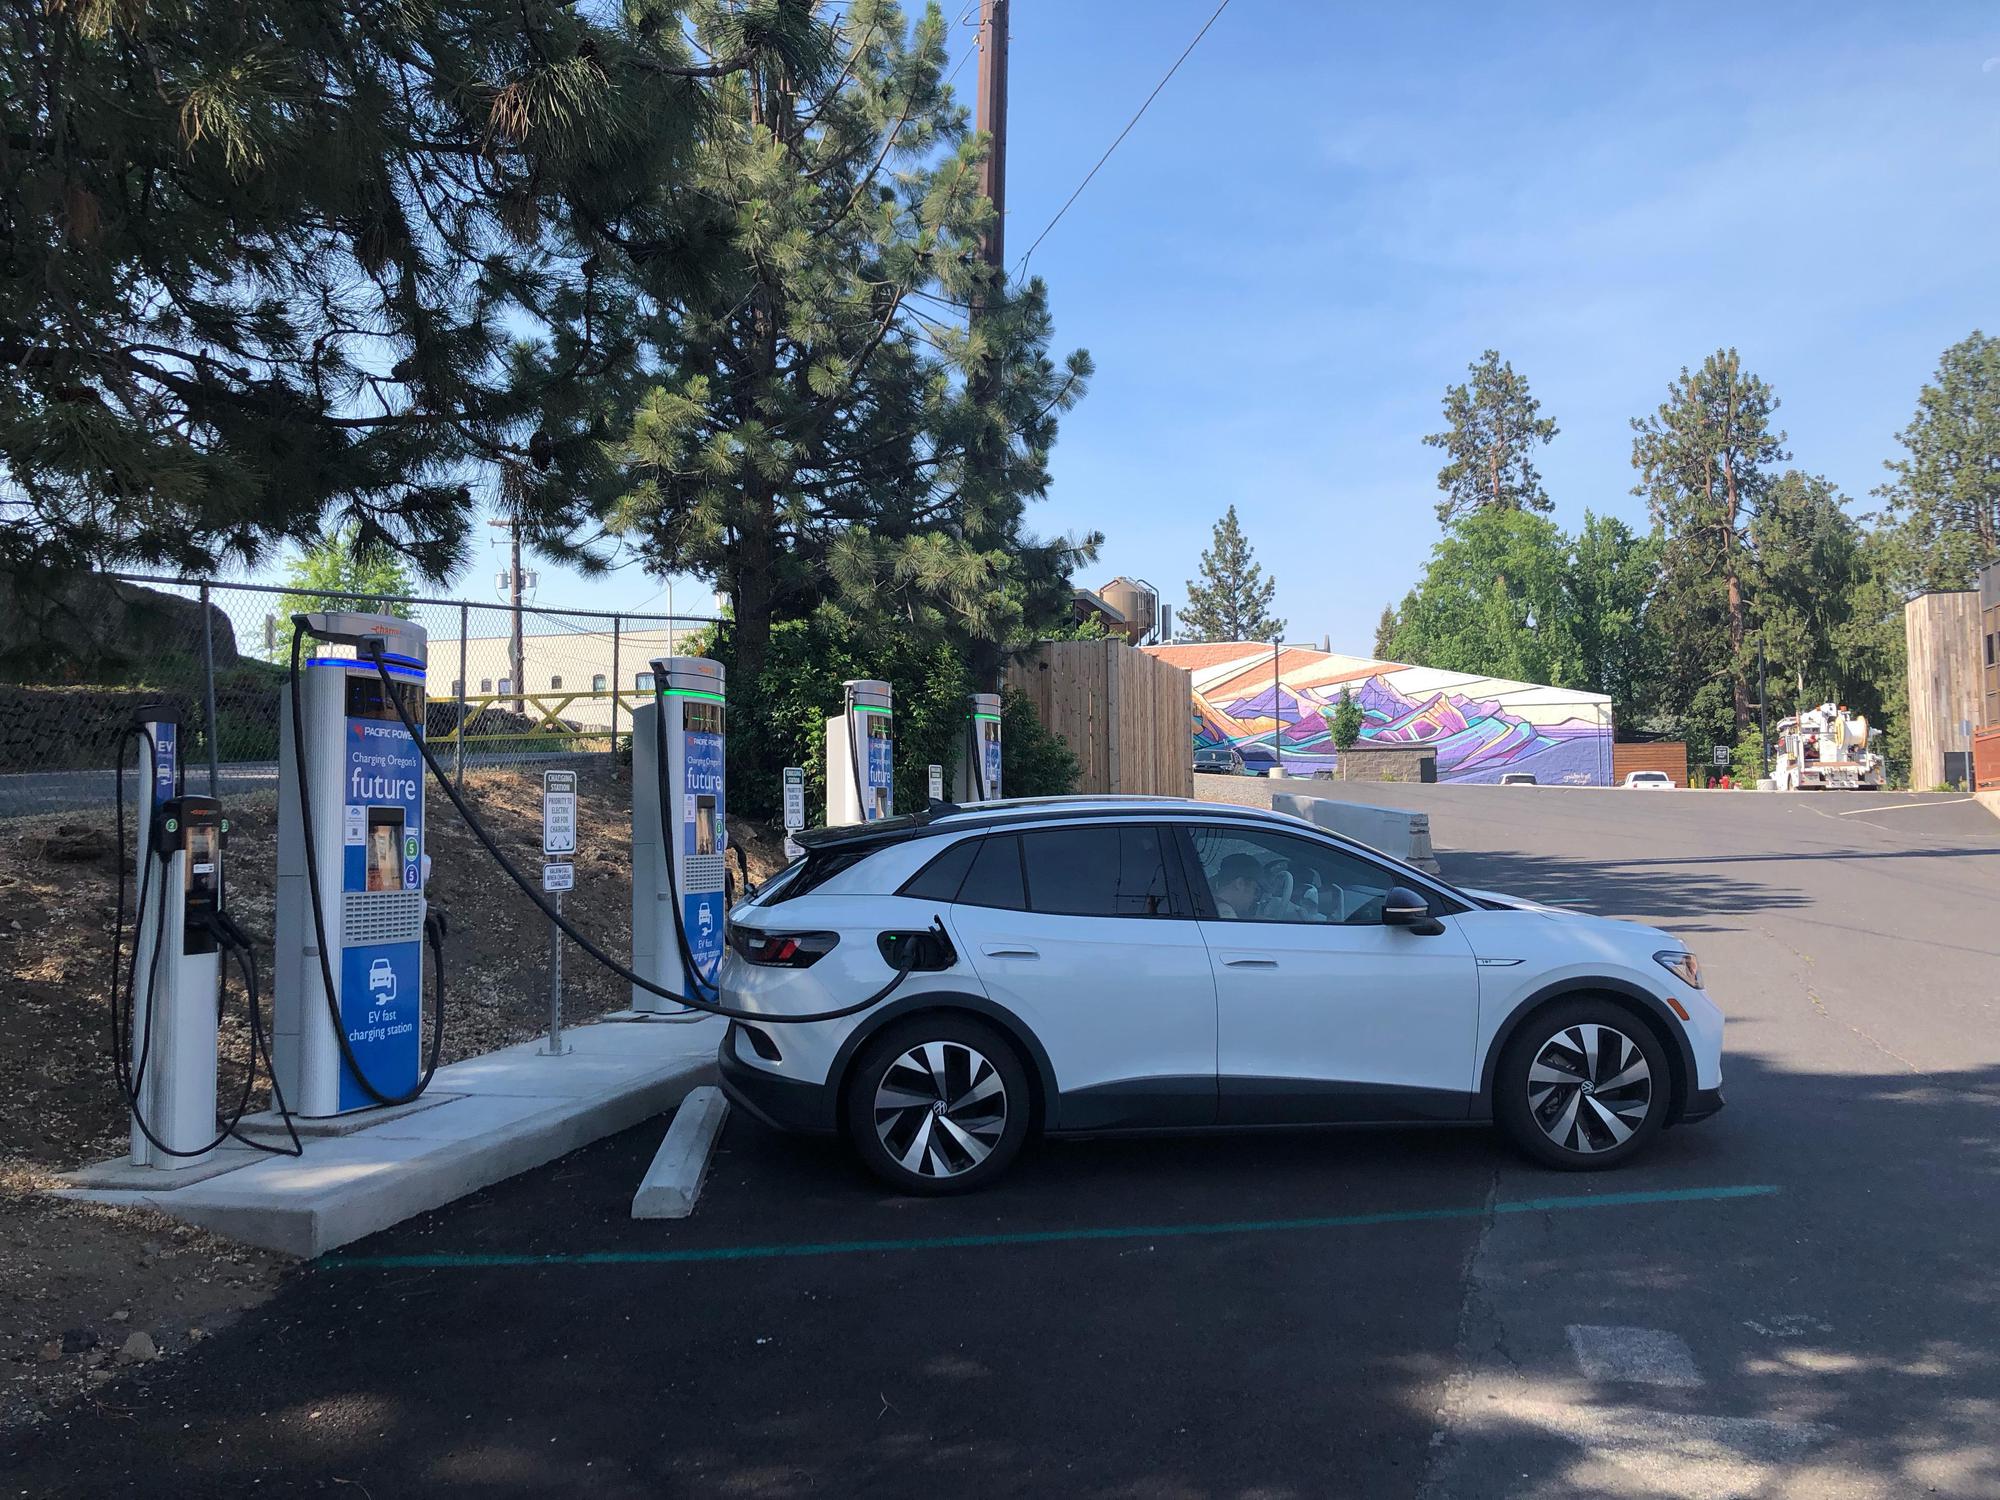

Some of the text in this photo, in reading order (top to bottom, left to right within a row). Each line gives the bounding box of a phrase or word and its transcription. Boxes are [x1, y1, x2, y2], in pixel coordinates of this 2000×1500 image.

[364, 726, 414, 740] PACIFIC POWE
[158, 740, 174, 752] EV
[352, 751, 417, 769] Charging Oregon's
[548, 774, 573, 782] CHARGING
[687, 766, 721, 790] future
[869, 765, 891, 783] future
[351, 766, 416, 800] future
[550, 783, 570, 792] STATION
[551, 806, 569, 814] ELECTRIC
[552, 815, 569, 824] CAR FOR
[549, 825, 571, 833] CHARGING
[368, 1009, 397, 1024] EV fast
[348, 1022, 413, 1042] charging station
